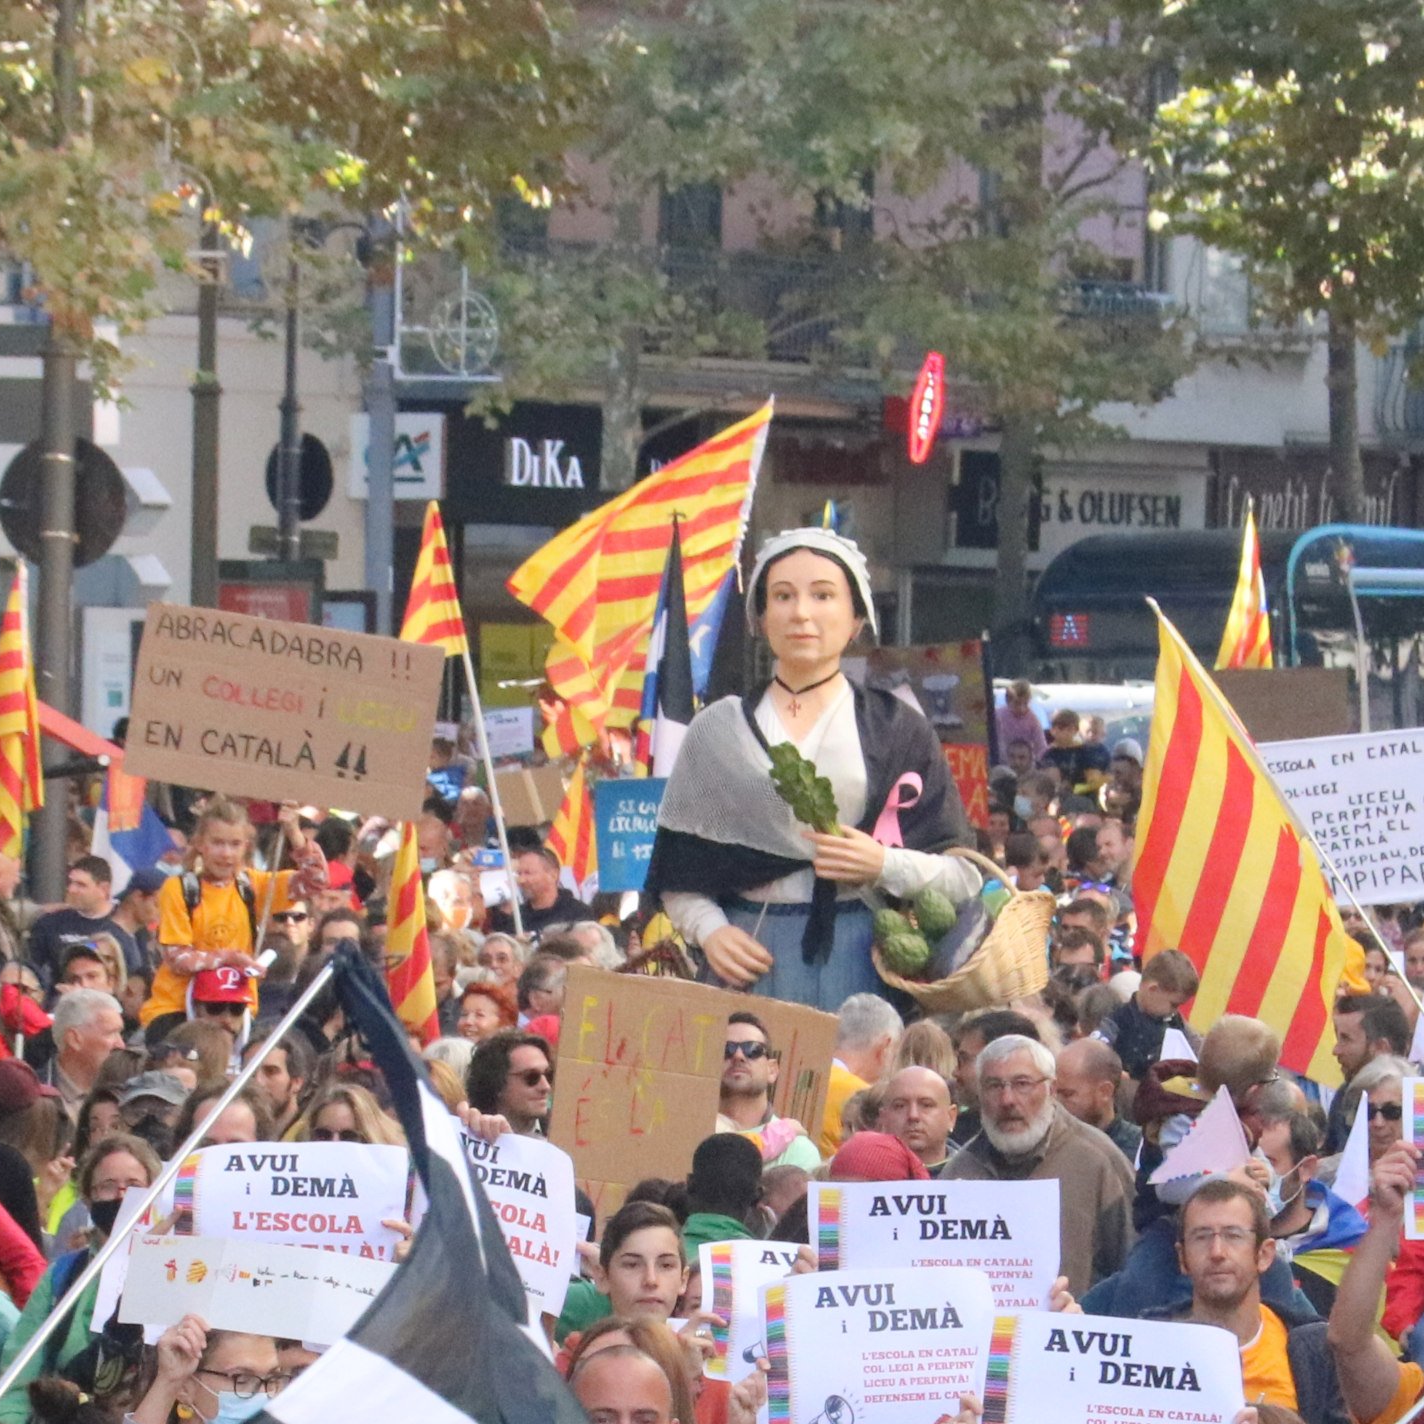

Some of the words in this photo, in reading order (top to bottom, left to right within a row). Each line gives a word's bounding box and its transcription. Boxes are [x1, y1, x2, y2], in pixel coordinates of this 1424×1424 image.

[1079, 491, 1182, 528] OLUFSEN
[155, 613, 364, 674] ABRACADABRA
[149, 664, 183, 689] UN
[145, 719, 184, 751] EN
[200, 729, 317, 770] CATALÀ
[1331, 751, 1355, 766] EN
[1348, 789, 1406, 806] LICEU
[1314, 822, 1372, 839] NSEM
[1387, 819, 1411, 832] EL
[224, 1154, 300, 1173] AVUI
[245, 1182, 252, 1195] i
[270, 1173, 359, 1199] DEMÀ
[868, 1194, 948, 1217] AVUI
[232, 1211, 365, 1234] L'ESCOLA
[893, 1228, 899, 1241] i
[918, 1214, 1012, 1241] DEMÀ
[911, 1258, 963, 1267] L'ESCOLA
[966, 1258, 982, 1267] EN
[984, 1257, 1034, 1267] CATALÀ!
[814, 1283, 896, 1309] AVUI
[841, 1320, 848, 1334] i
[868, 1302, 964, 1333] DEMÀ
[1044, 1328, 1133, 1358] AVUI
[862, 1350, 917, 1361] L'ESCOLA
[918, 1350, 934, 1360] EN
[863, 1364, 885, 1374] COL
[887, 1363, 914, 1374] LEGI
[915, 1363, 926, 1372] A
[1069, 1367, 1076, 1382] i
[1098, 1361, 1202, 1392] DEMÀ
[863, 1378, 896, 1388] LICEU
[897, 1377, 908, 1387] A
[909, 1374, 970, 1387] PERPINYÀ!
[863, 1392, 928, 1403] DEFENSEM
[930, 1392, 943, 1401] EL
[1086, 1404, 1145, 1418] L'ESCOLA
[1148, 1409, 1165, 1419] EN
[1167, 1410, 1223, 1424] CATALÀ!
